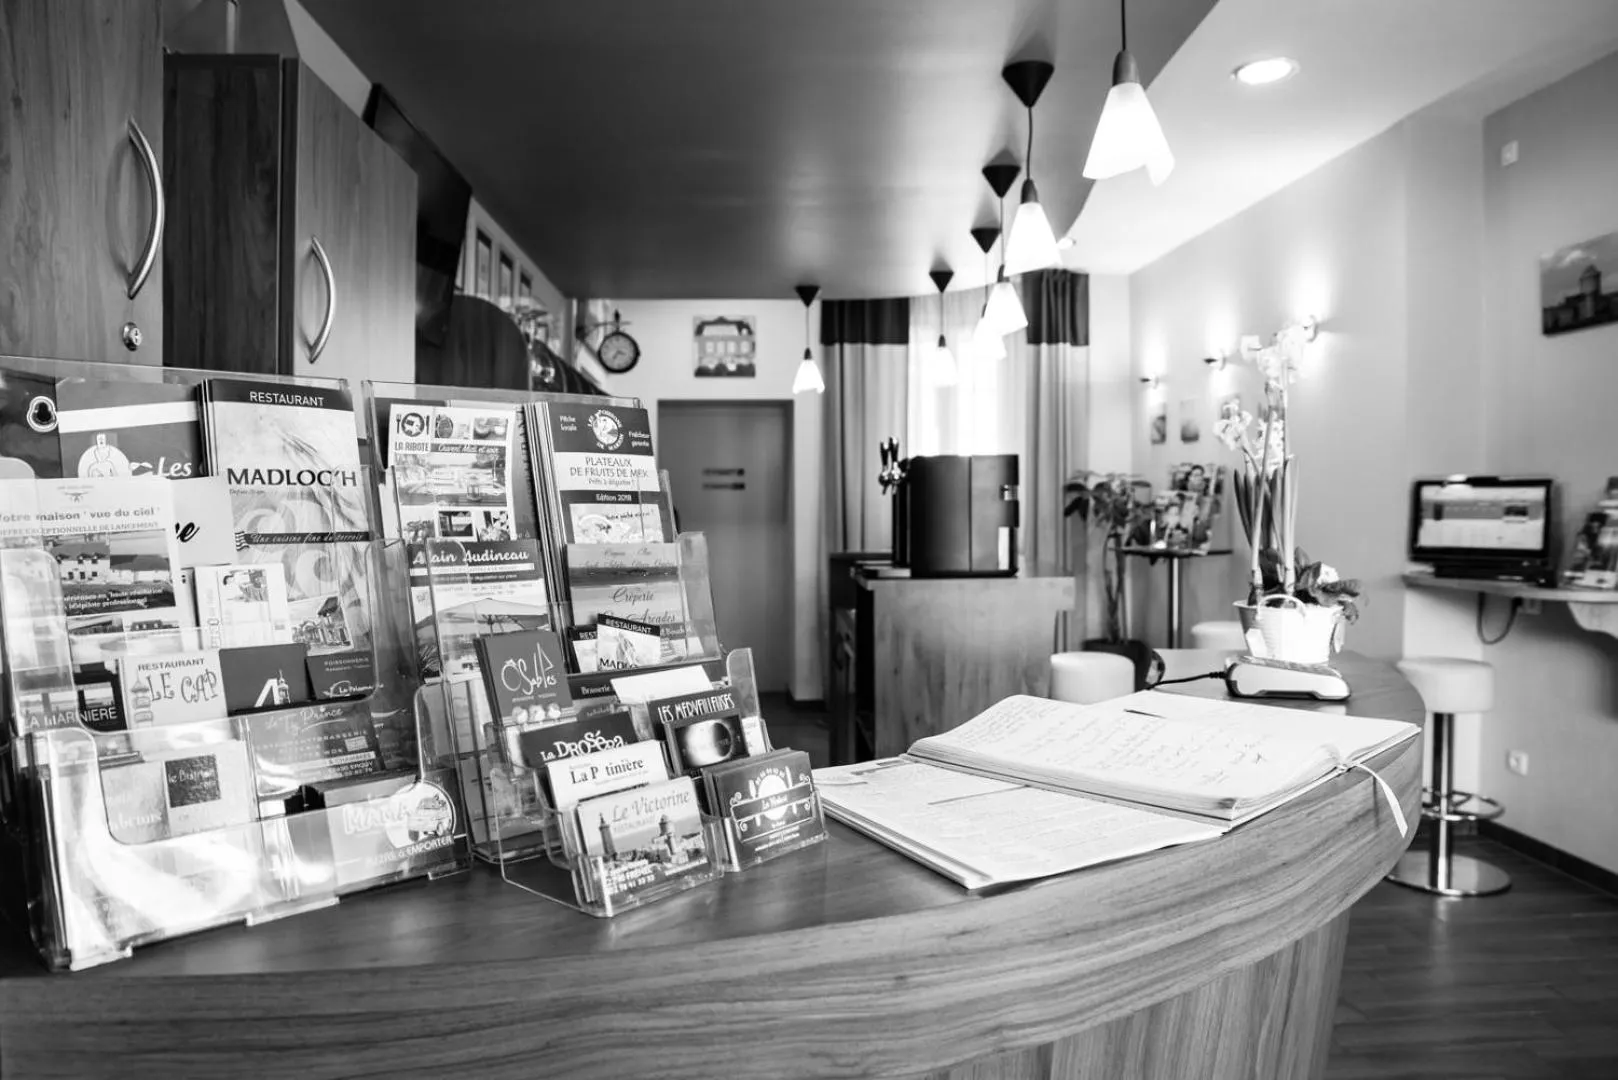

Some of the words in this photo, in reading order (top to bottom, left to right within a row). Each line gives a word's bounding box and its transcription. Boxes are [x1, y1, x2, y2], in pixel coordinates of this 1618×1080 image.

[249, 391, 325, 407] RESTAURANT
[585, 456, 632, 467] PLATEAUX
[227, 467, 357, 487] MADLOC'H
[570, 466, 584, 477] DE
[585, 467, 615, 477] FRUITS
[616, 468, 629, 478] DE
[36, 511, 81, 521] maison
[114, 508, 130, 517] du
[463, 548, 530, 564] Audineau
[609, 586, 654, 605] Crêperie
[605, 618, 652, 634] RESTAURANT
[138, 658, 205, 672] RESTAURANT
[146, 672, 176, 703] LE
[181, 669, 218, 704] CAP
[658, 705, 675, 724] LES
[570, 770, 589, 785] La
[590, 758, 645, 780] Ptinière
